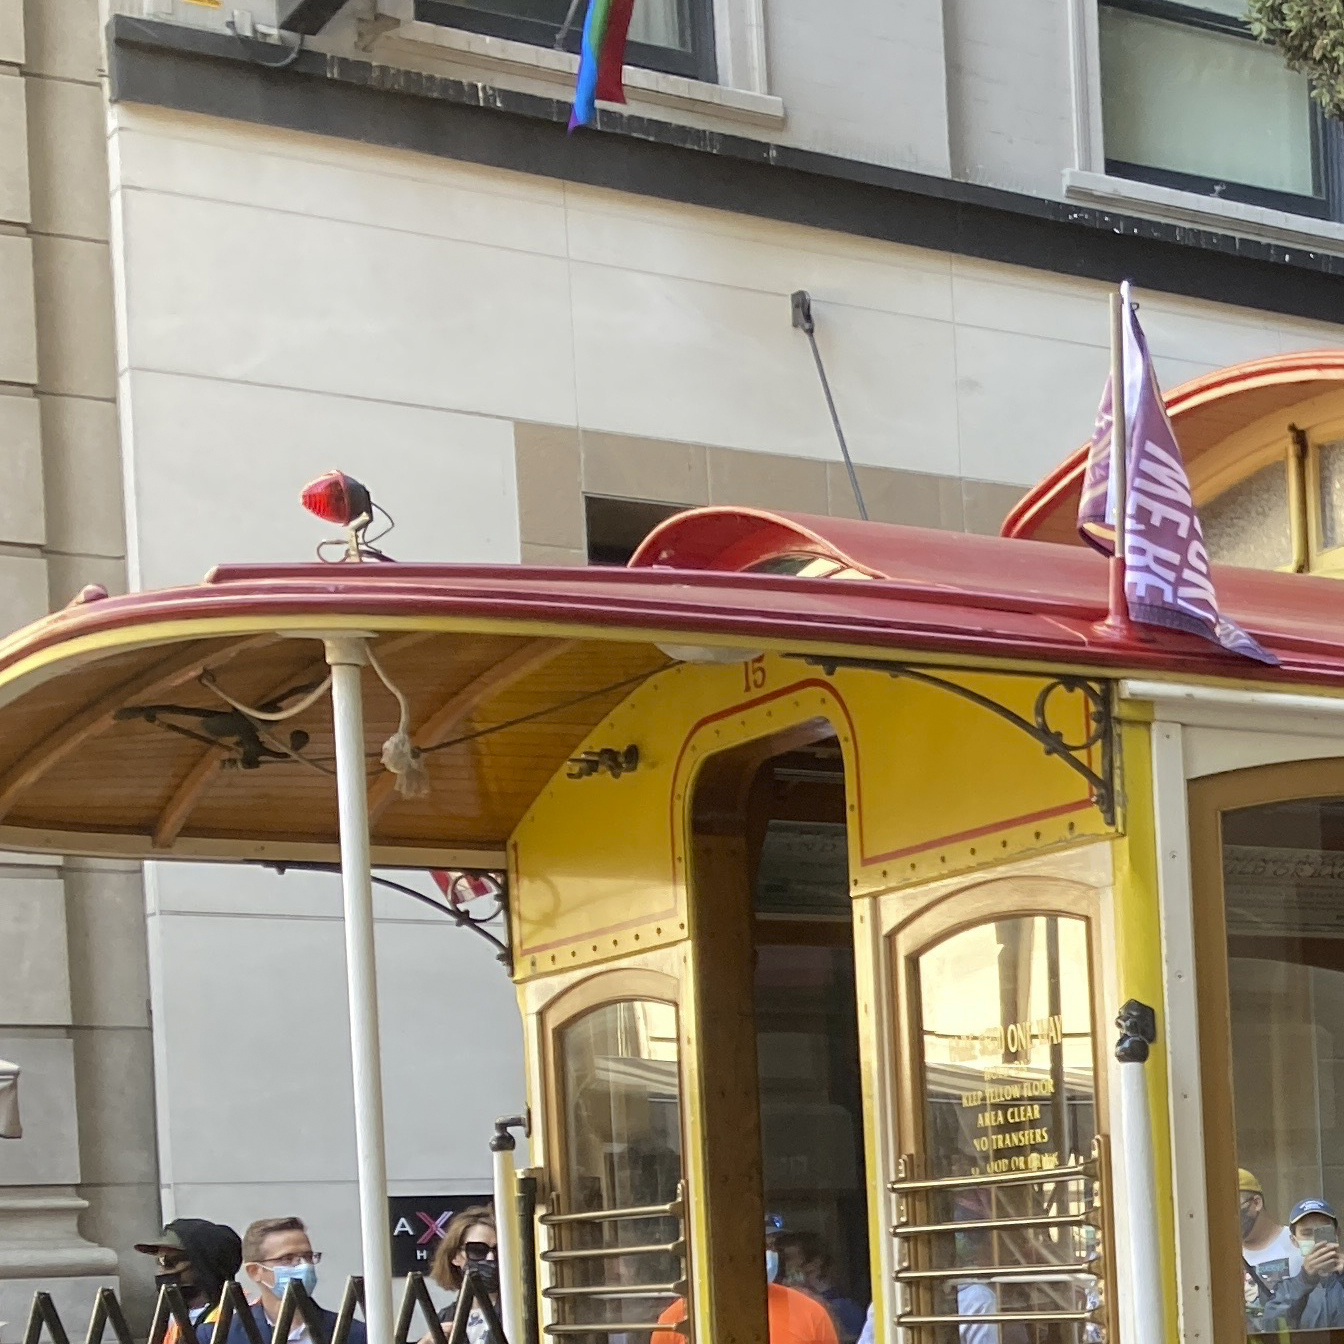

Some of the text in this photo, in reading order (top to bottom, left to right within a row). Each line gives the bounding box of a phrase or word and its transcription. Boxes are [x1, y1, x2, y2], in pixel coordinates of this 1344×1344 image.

[743, 652, 767, 693] 15
[1006, 1020, 1033, 1054] ONE
[1022, 1077, 1055, 1099] FLOOR
[976, 1104, 1041, 1128] AREA CLEAR
[973, 1126, 1049, 1152] NO TRANSFERS
